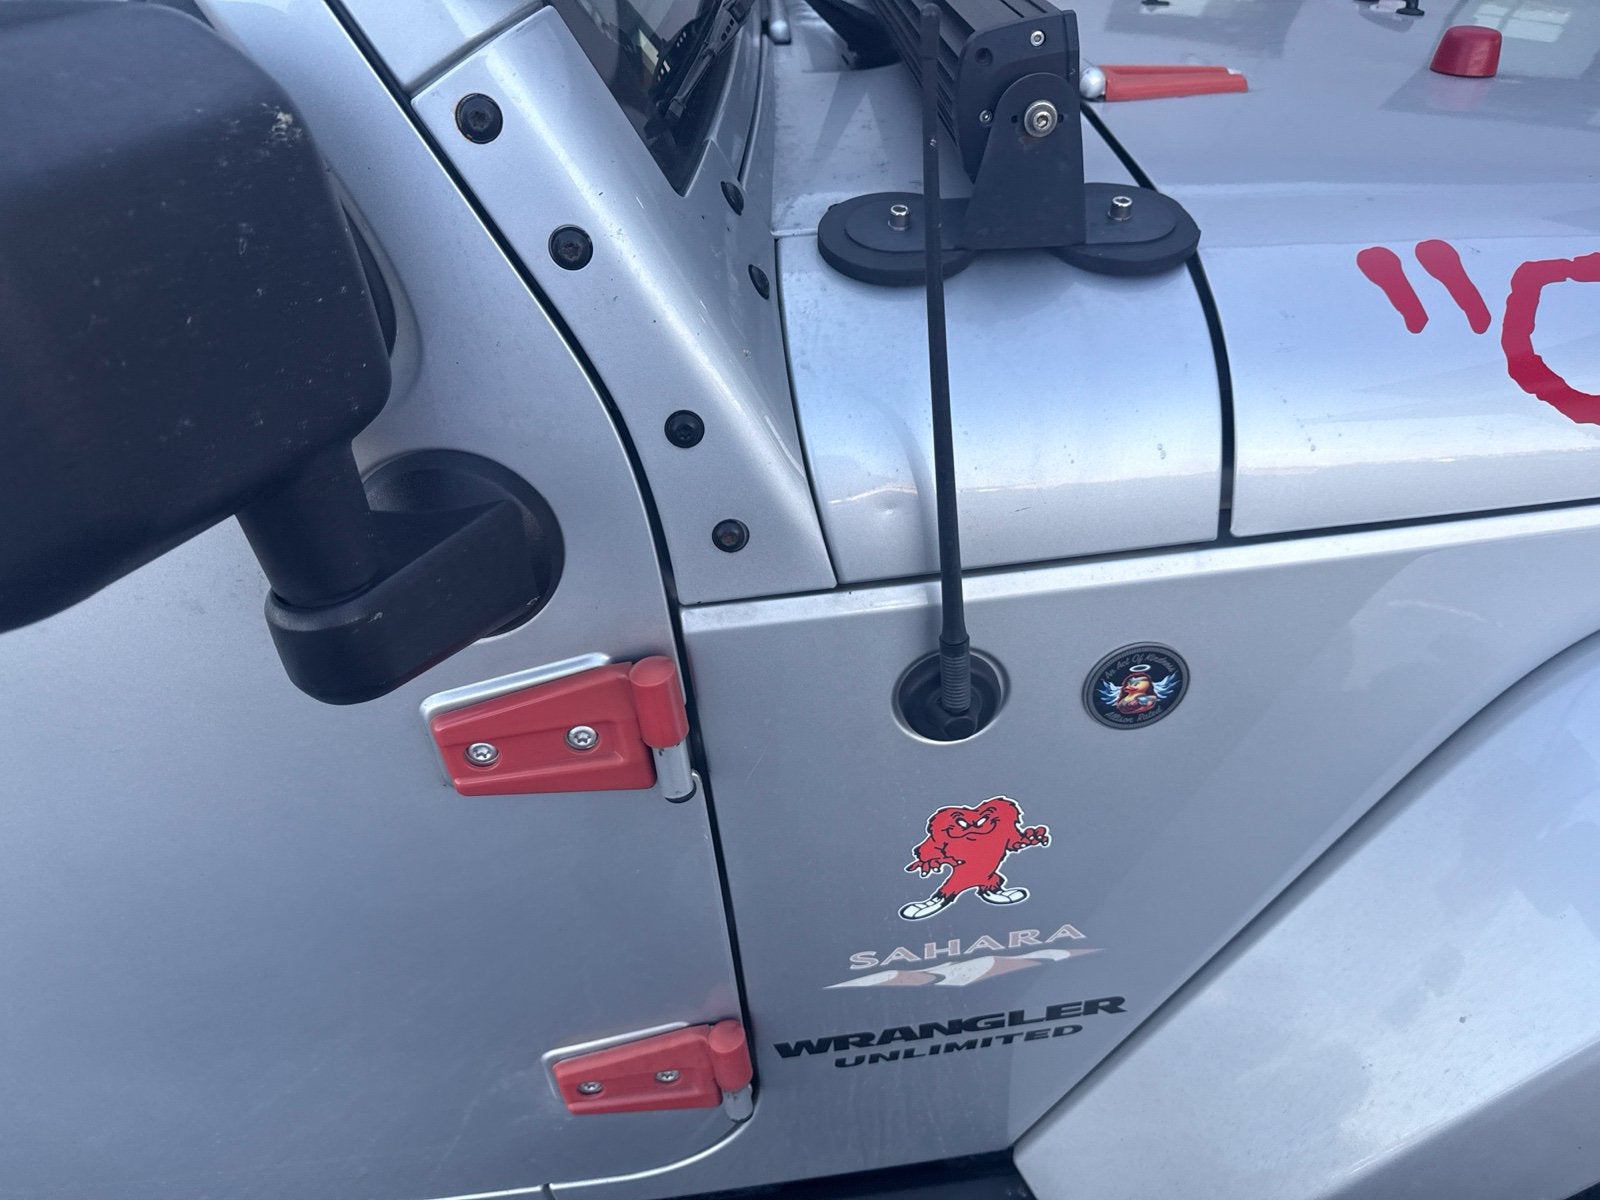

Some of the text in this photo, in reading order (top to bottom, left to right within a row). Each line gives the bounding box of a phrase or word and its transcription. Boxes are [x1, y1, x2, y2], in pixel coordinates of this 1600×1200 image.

[1104, 669, 1117, 679] An
[1117, 658, 1131, 671] Act
[1131, 653, 1144, 665] Of
[849, 923, 1087, 971] SAHARA
[773, 995, 1128, 1059] WRANGLER
[834, 1024, 1083, 1069] UNLIMITED
